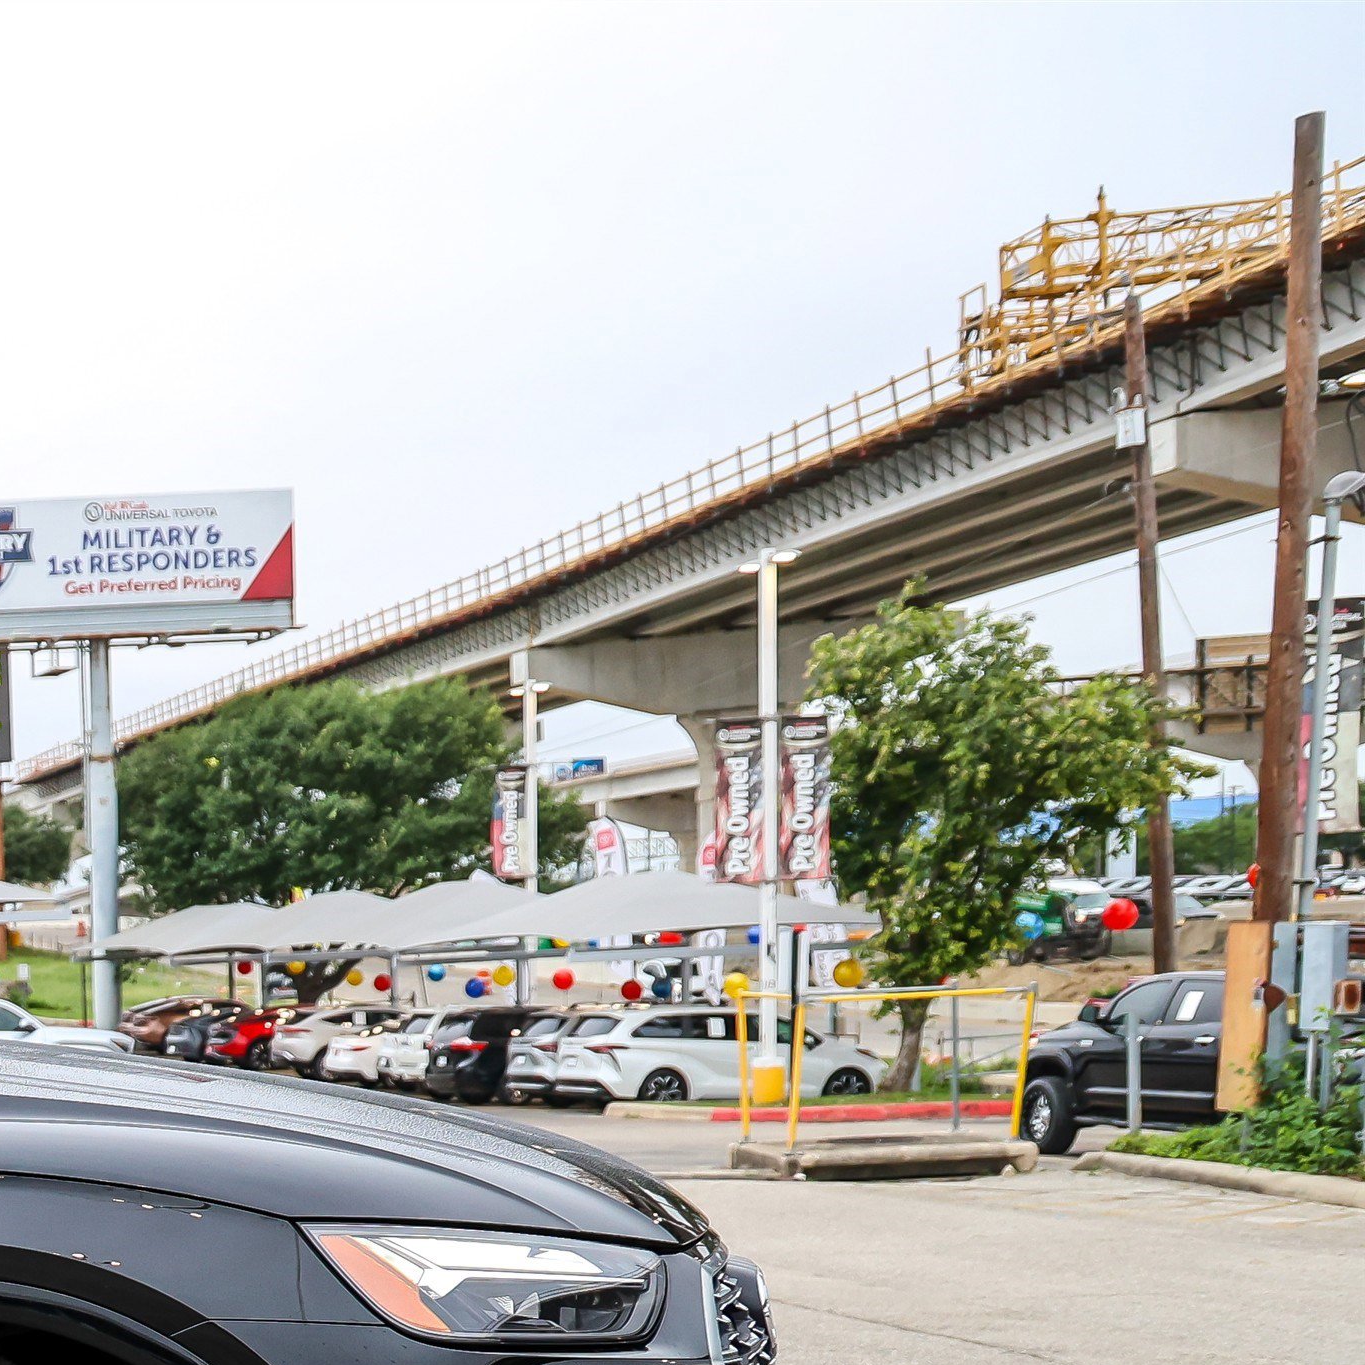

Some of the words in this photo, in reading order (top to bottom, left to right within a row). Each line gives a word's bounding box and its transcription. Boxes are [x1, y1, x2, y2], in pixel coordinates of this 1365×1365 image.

[105, 508, 170, 520] UNIVERSAL
[82, 525, 199, 550] MILITARY
[206, 524, 222, 545] &
[48, 555, 83, 576] 1st
[90, 547, 258, 573] RESPONDERS
[64, 580, 93, 595] Get
[99, 577, 178, 593] Preferred
[183, 574, 242, 592] Pricing
[725, 756, 750, 835] Owned
[790, 753, 815, 834] Owned
[500, 790, 519, 845] Owned
[501, 846, 519, 873] Pre
[725, 836, 751, 875] Pre
[790, 834, 815, 871] Pre
